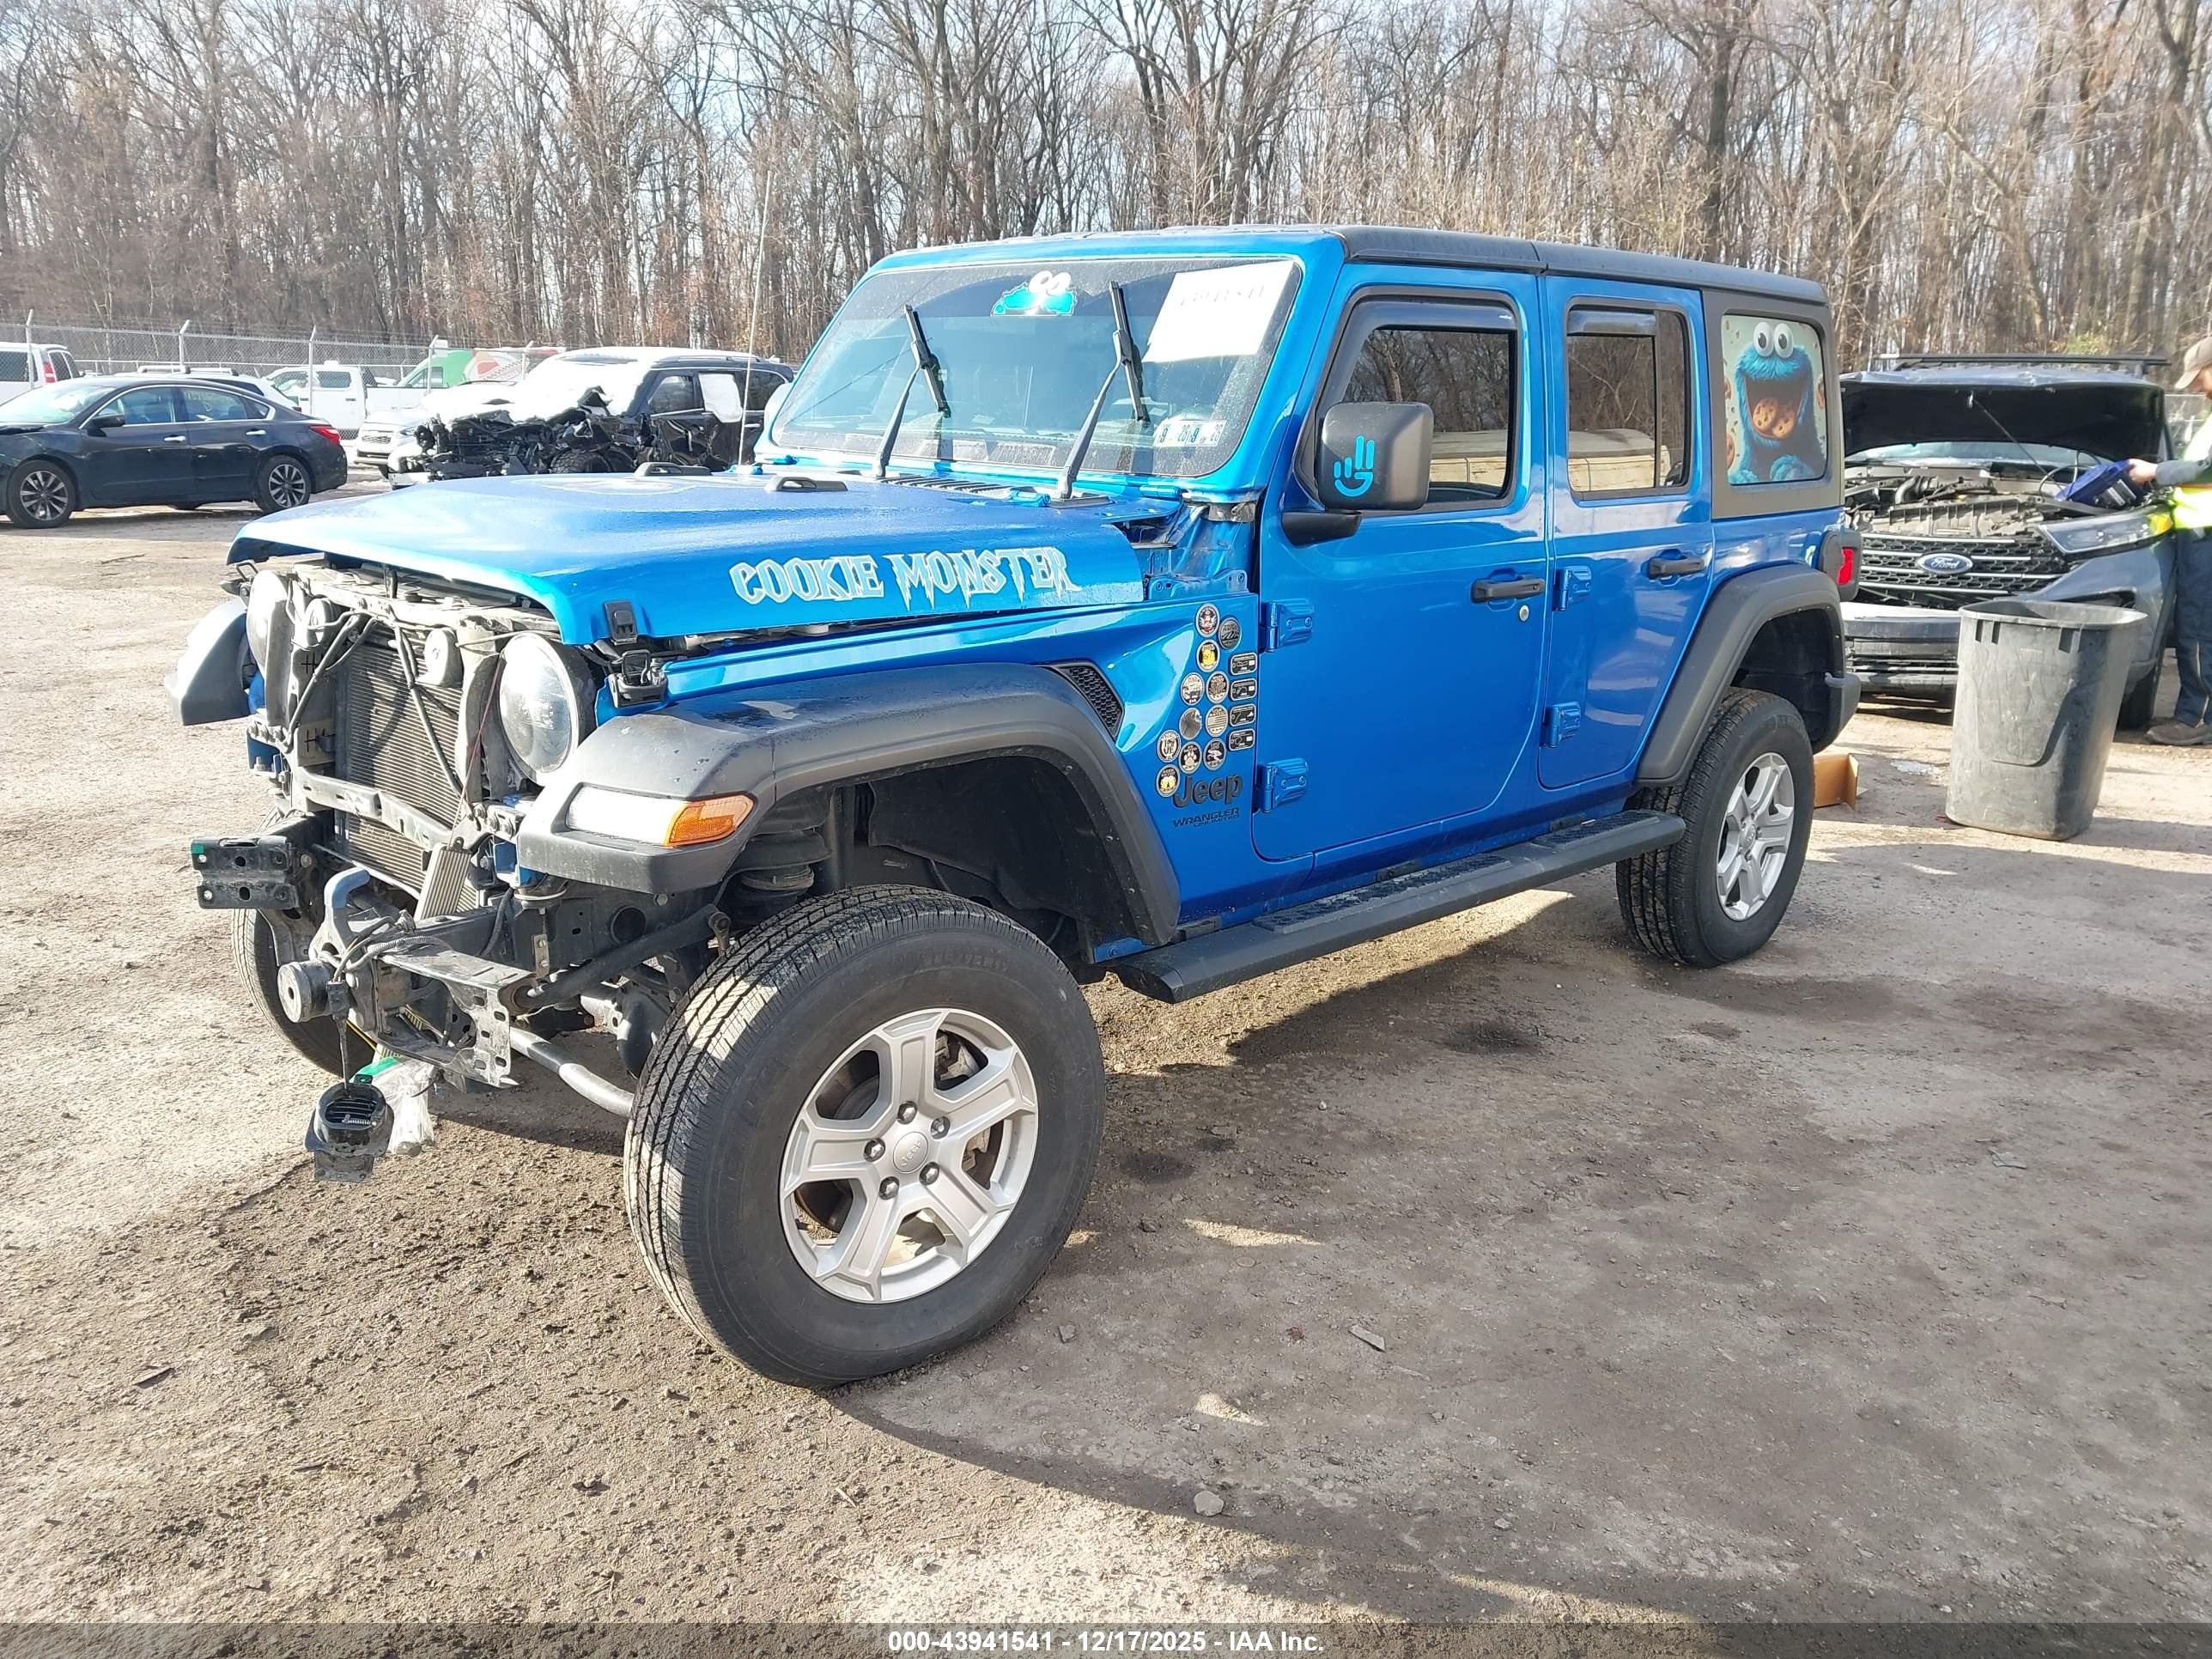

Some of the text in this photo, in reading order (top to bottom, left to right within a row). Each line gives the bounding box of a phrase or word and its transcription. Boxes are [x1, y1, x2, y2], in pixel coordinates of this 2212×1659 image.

[1930, 556, 1960, 569] Ford
[729, 546, 1083, 612] COOKIE MONSTER
[1172, 775, 1243, 807] Jeep
[1172, 807, 1240, 828] WRANGLER
